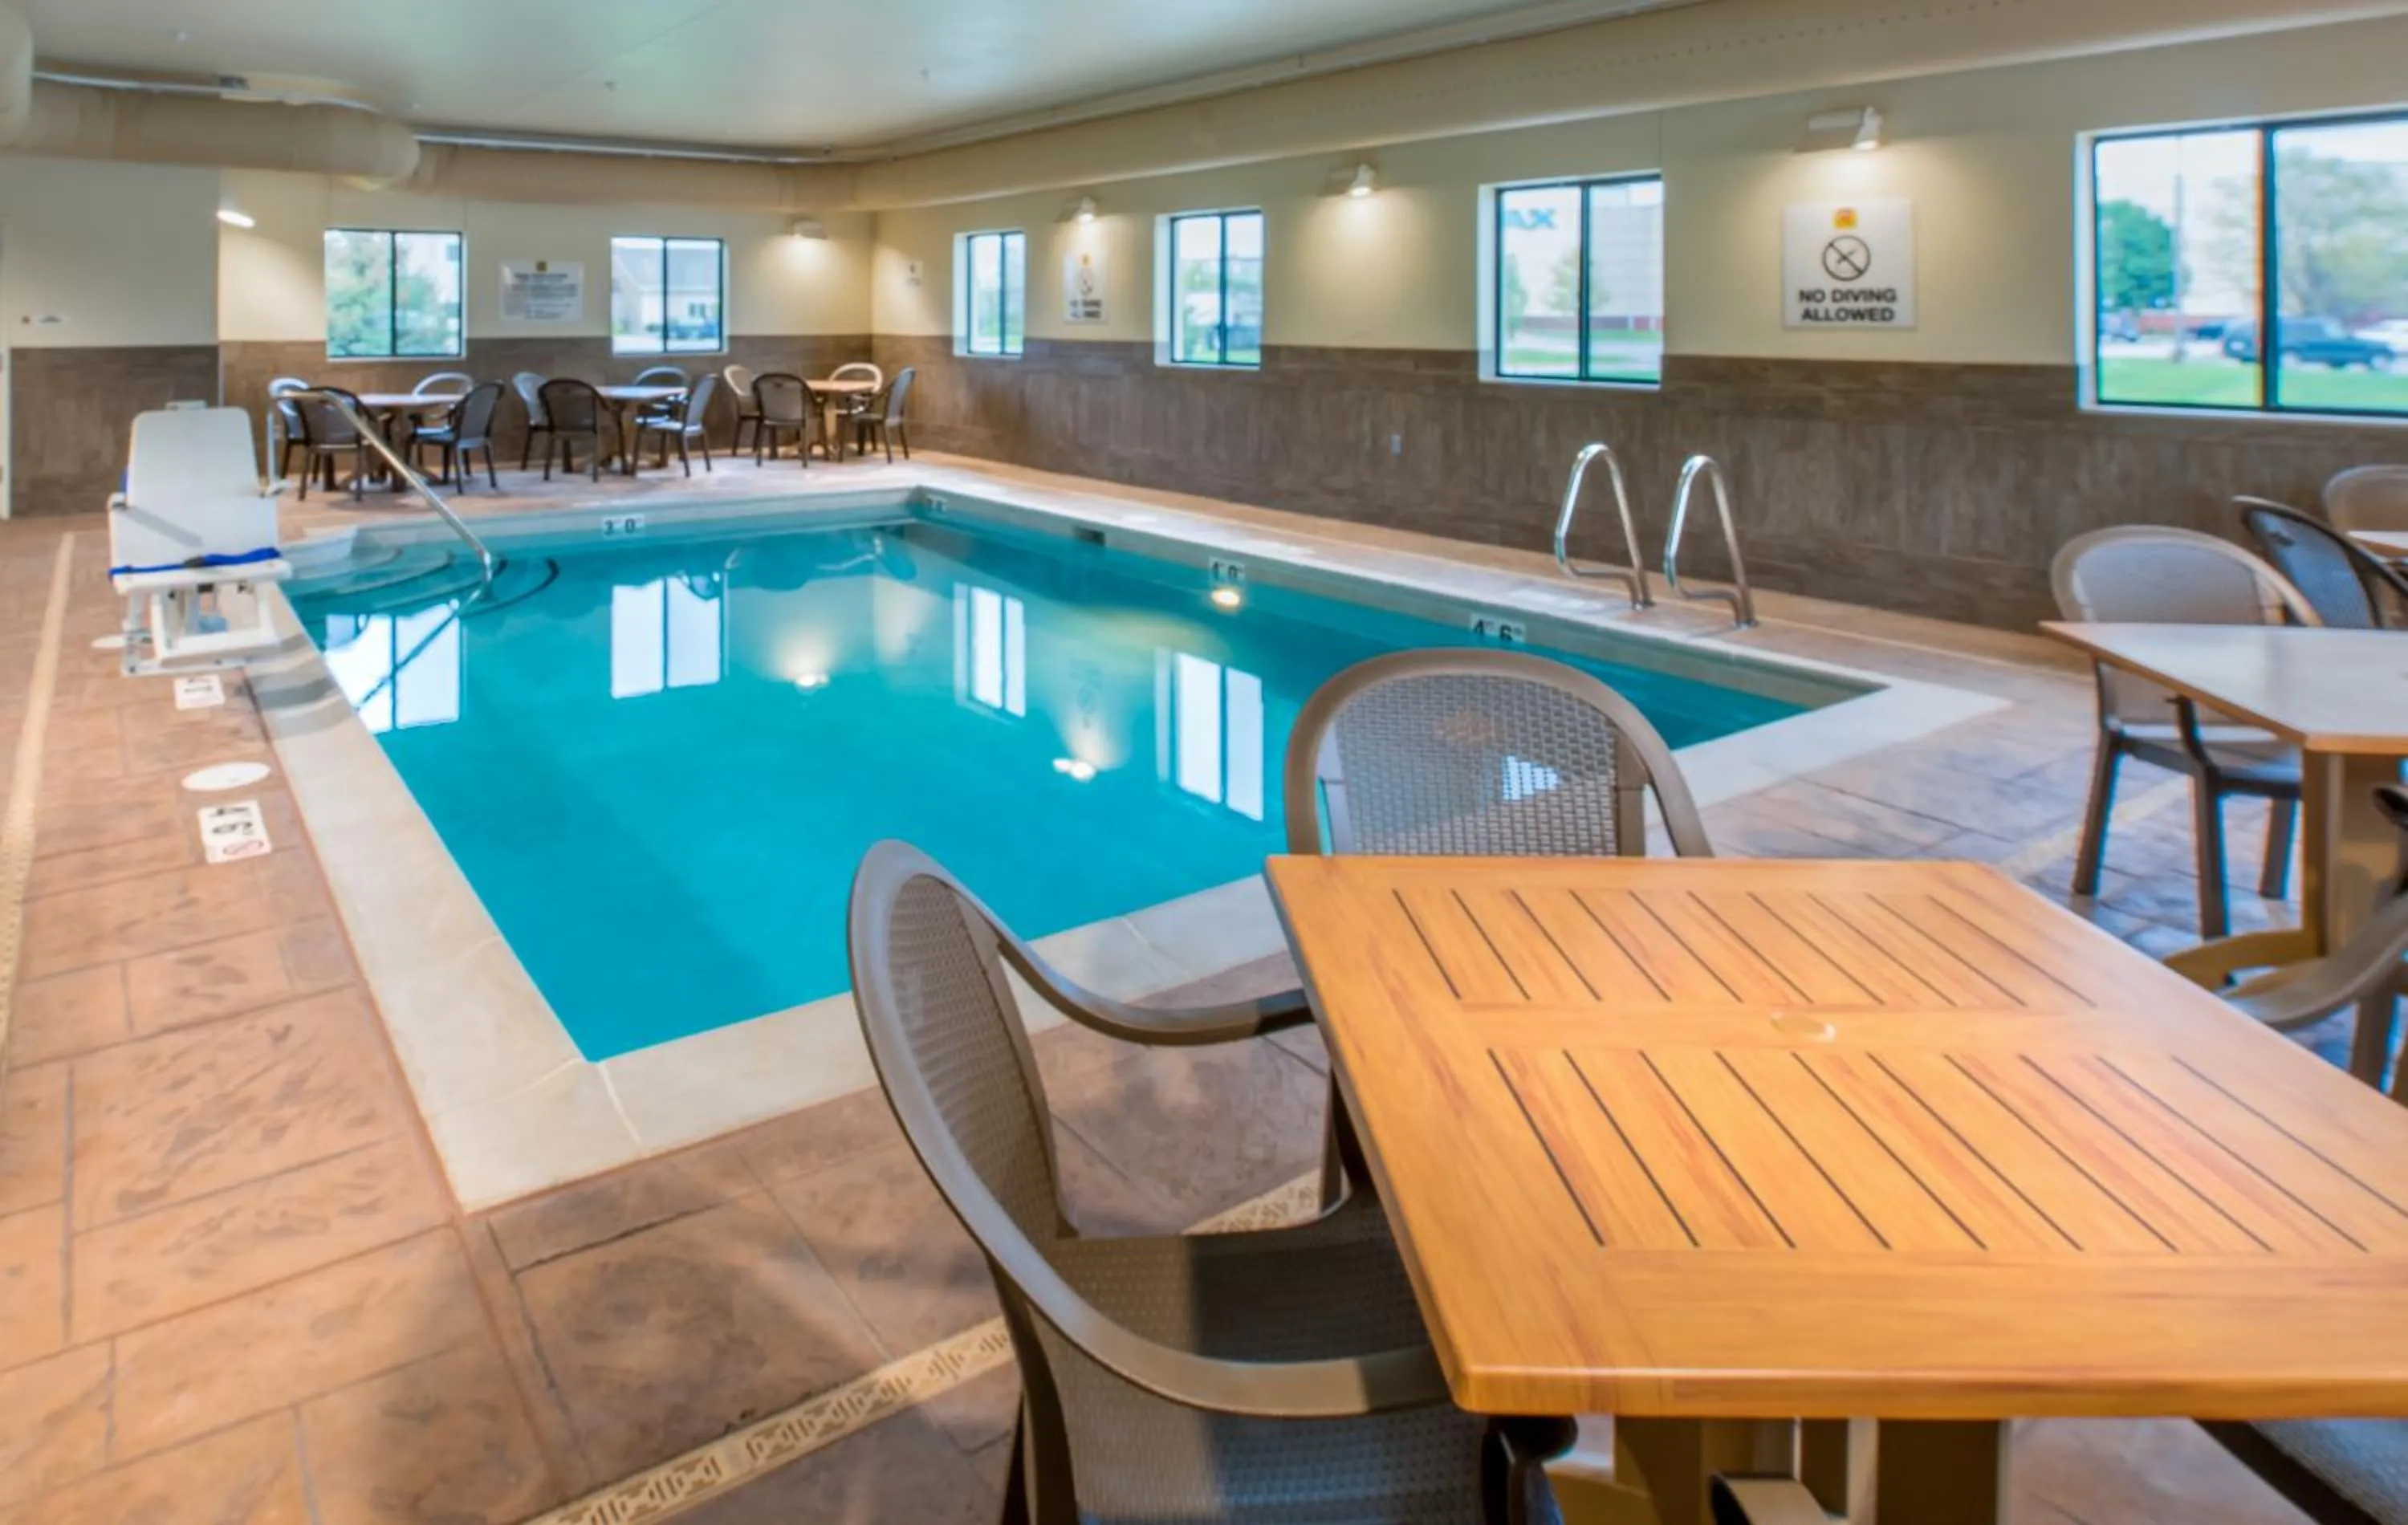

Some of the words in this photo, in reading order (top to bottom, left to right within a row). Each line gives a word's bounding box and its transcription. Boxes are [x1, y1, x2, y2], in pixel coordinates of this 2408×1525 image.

[1799, 289, 1826, 303] NO
[1831, 288, 1898, 303] DIVING
[1801, 307, 1895, 321] ALLOWED
